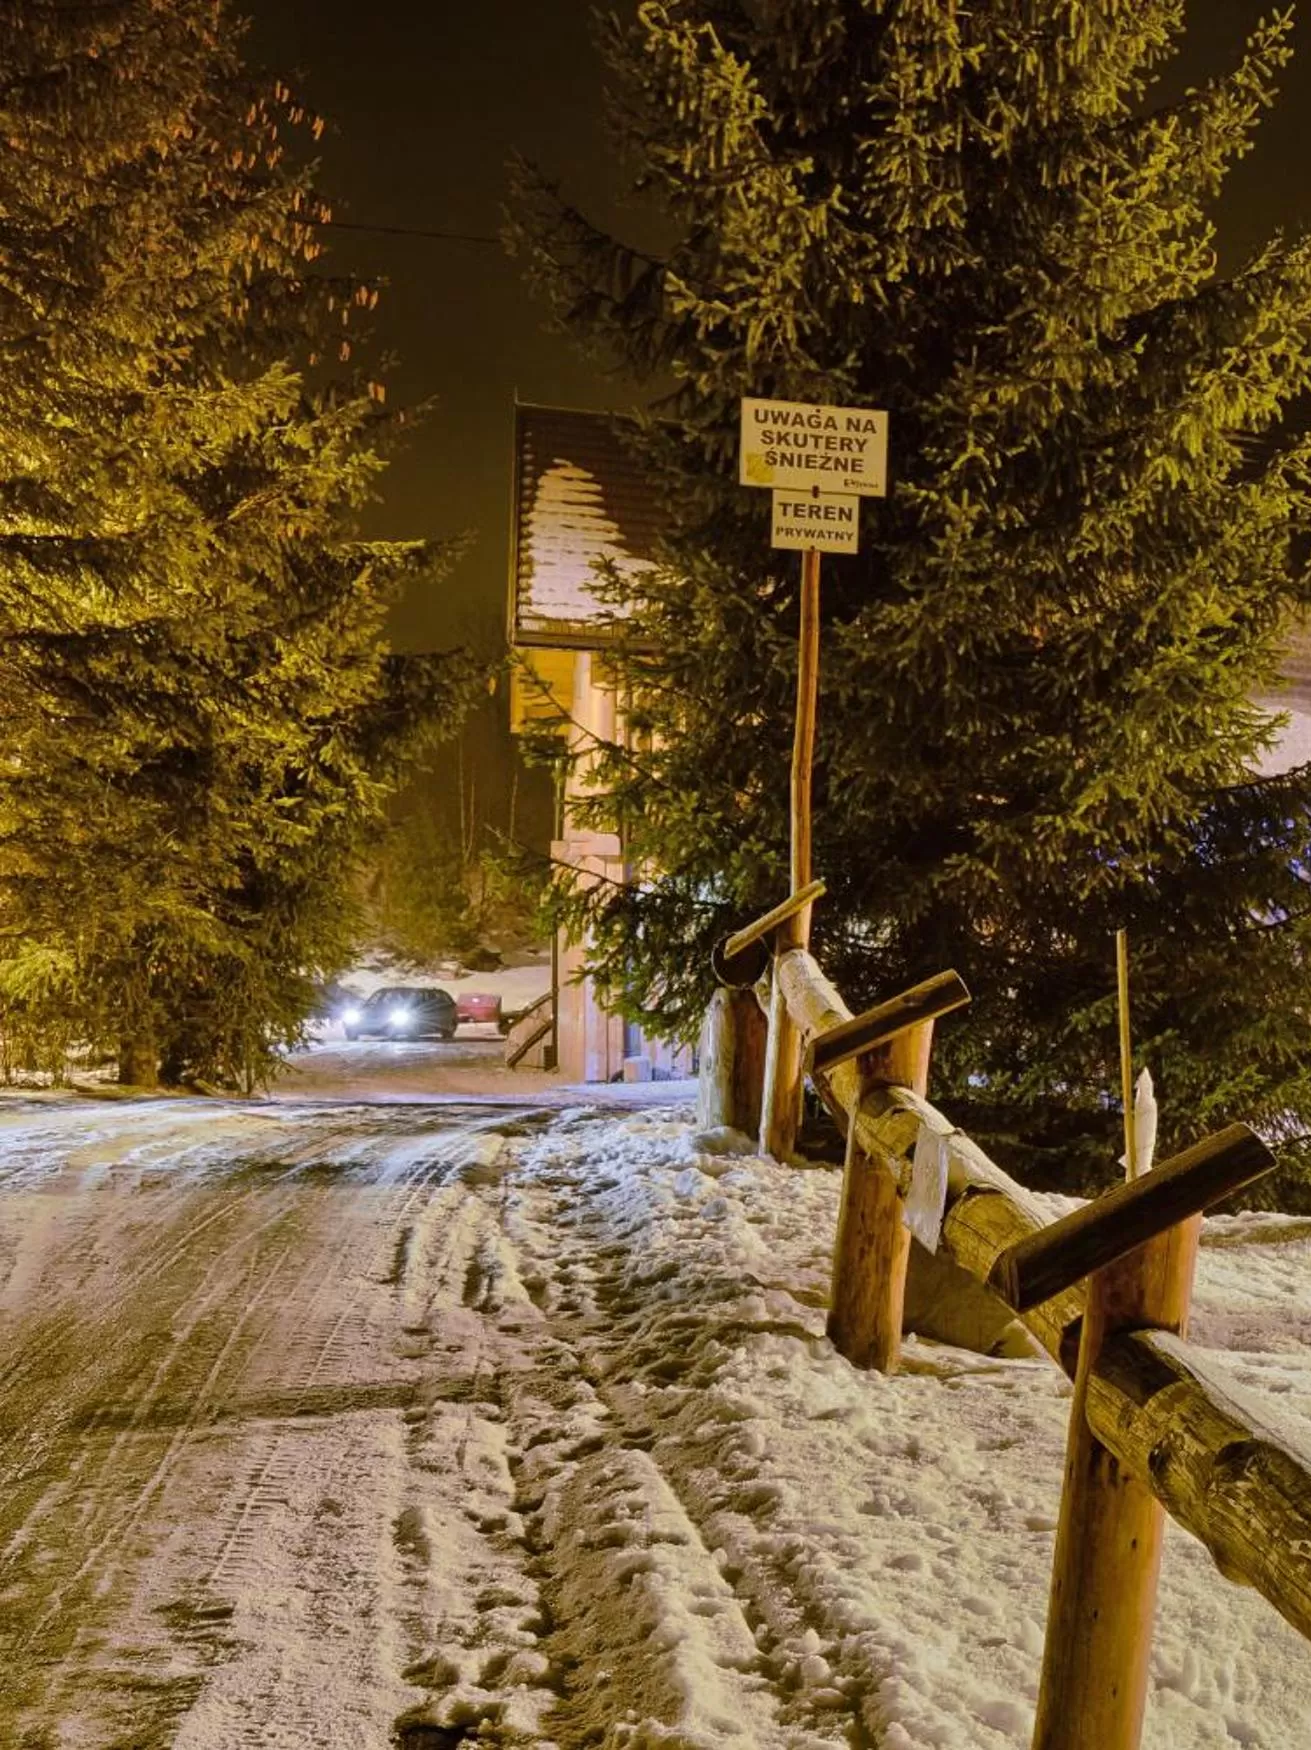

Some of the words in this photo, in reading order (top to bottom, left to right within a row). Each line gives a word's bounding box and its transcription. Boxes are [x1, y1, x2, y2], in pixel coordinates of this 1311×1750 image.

[754, 408, 838, 431] UWAGA
[846, 417, 877, 434] NA
[760, 429, 868, 453] SKUTERY
[765, 447, 865, 473] ŚNIEŻNE
[777, 502, 853, 522] TEREN
[776, 526, 855, 541] PRYWATNY
